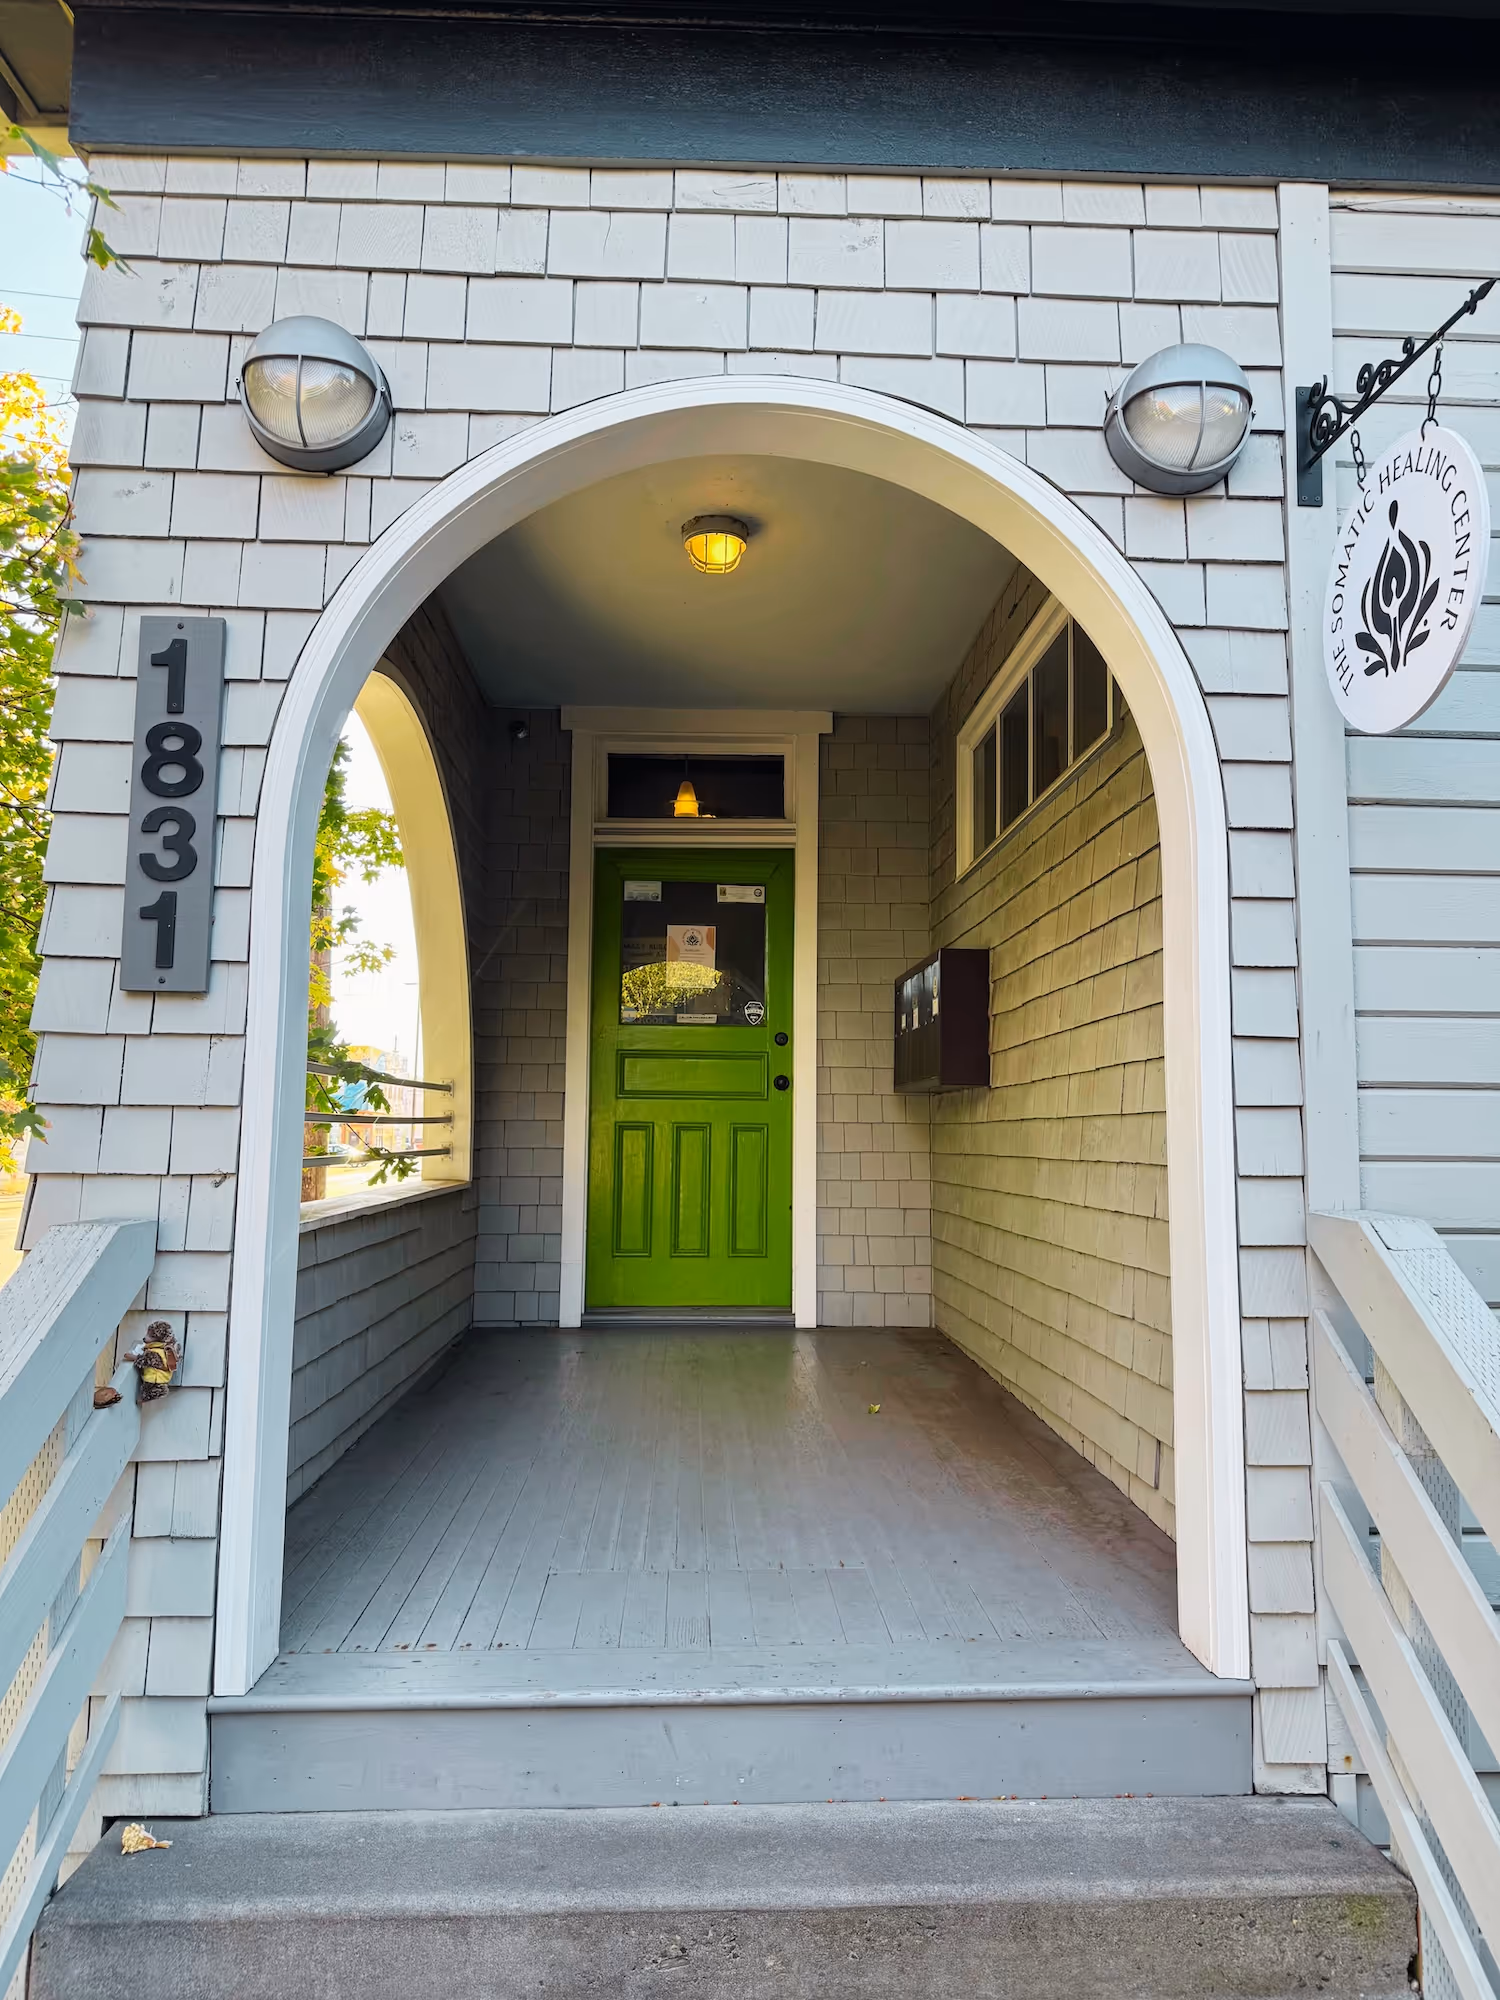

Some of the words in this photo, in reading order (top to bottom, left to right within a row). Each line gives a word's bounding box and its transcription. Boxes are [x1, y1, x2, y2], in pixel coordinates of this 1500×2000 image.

[1378, 446, 1458, 495] HEALING
[1331, 490, 1375, 634] SOMATIC
[1439, 490, 1471, 631] CENTER
[1333, 638, 1355, 697] THE
[139, 638, 204, 969] 1831
